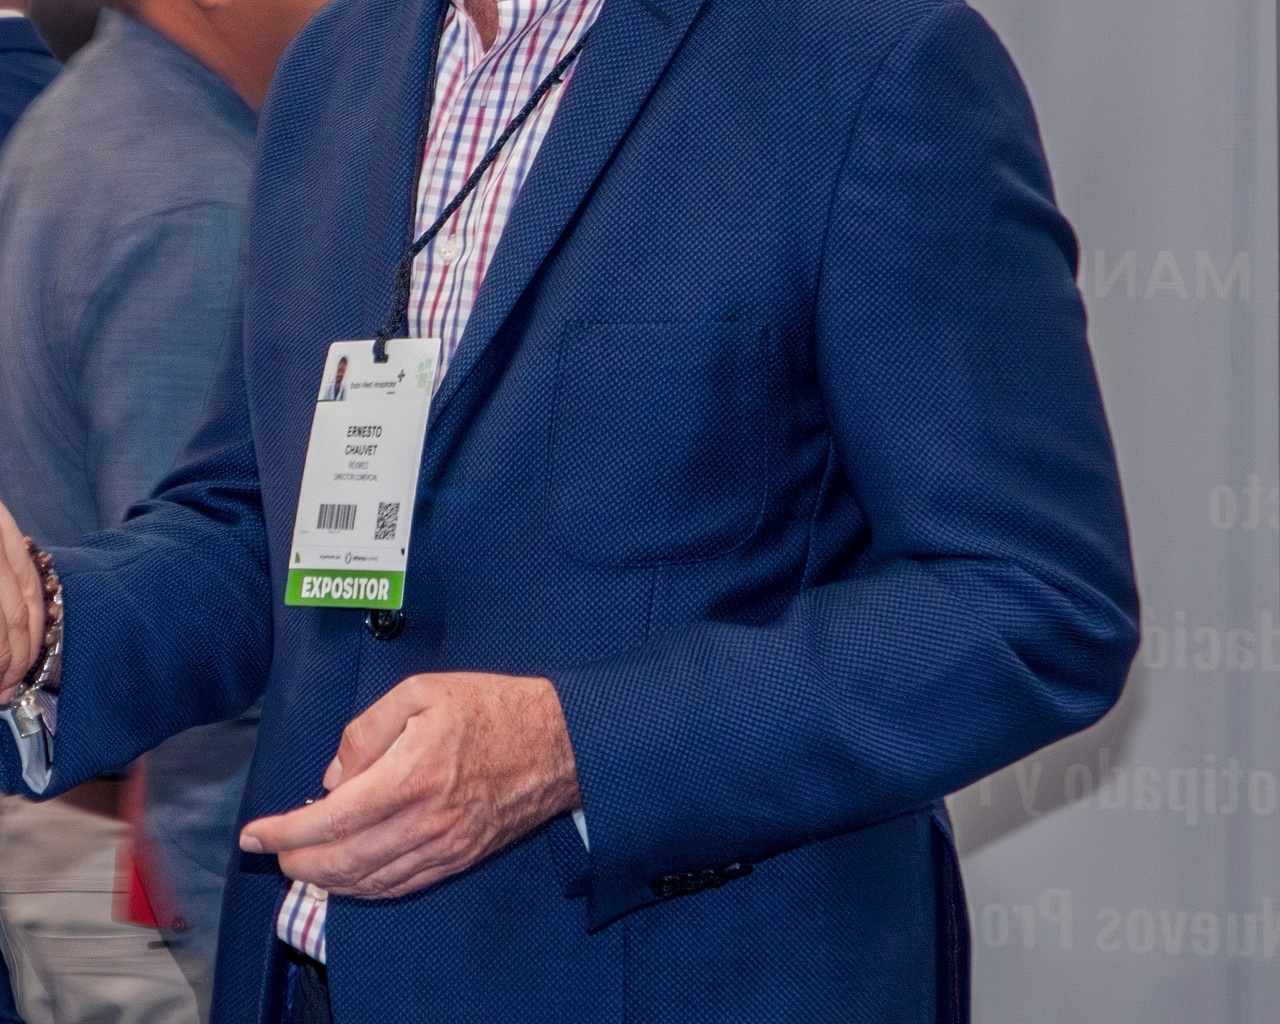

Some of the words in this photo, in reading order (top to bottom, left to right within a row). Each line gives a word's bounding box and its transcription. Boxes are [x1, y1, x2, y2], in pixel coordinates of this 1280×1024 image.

[346, 425, 383, 438] ERNESTO
[344, 444, 379, 456] CHAUVET
[300, 575, 390, 601] EXPOSITOR
